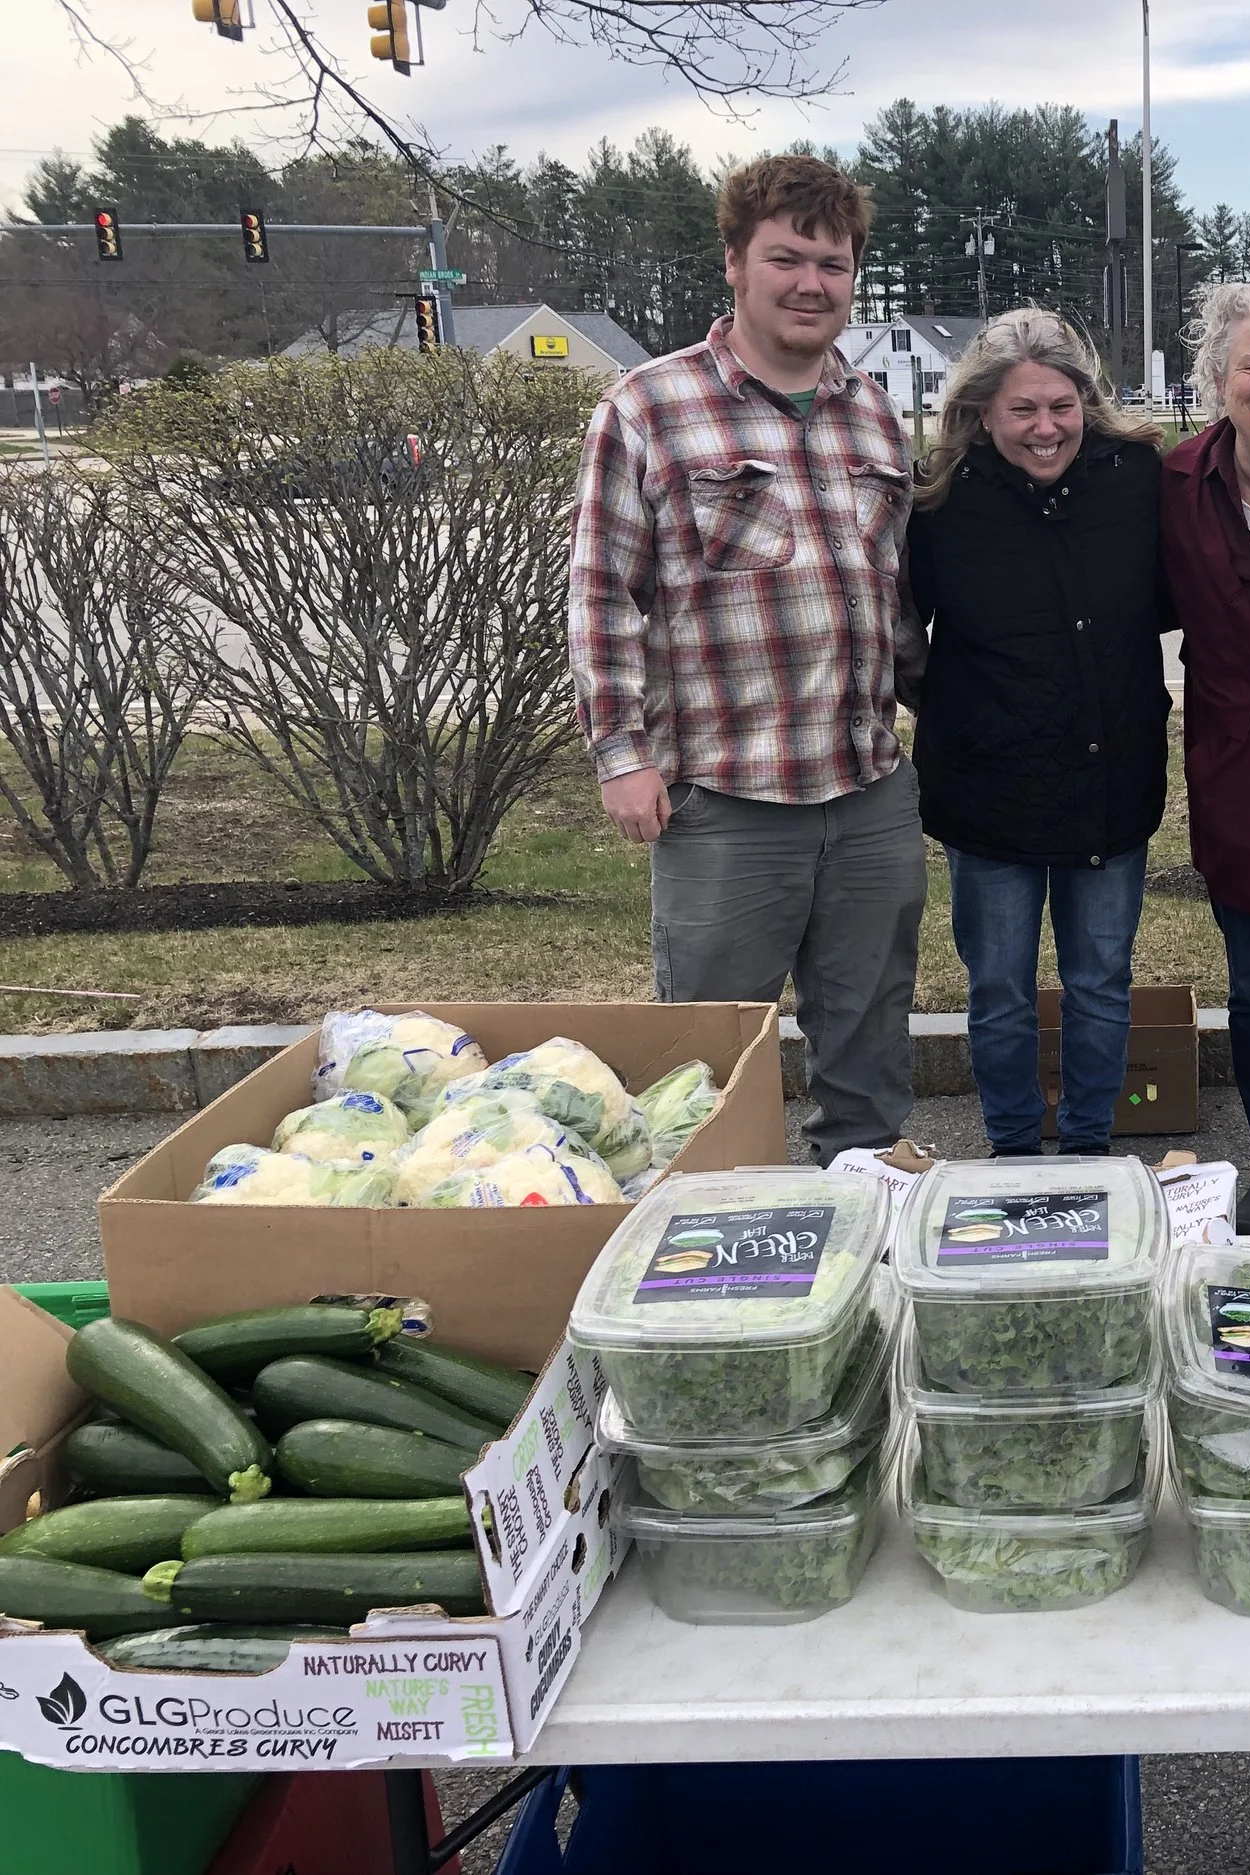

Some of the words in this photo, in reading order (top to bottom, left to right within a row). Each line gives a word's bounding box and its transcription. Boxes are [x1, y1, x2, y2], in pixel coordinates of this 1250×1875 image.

[1166, 1178, 1220, 1196] TURALLY
[1003, 1209, 1101, 1238] GREEN
[1024, 1206, 1048, 1217] LEAF
[740, 1225, 767, 1240] LEAF
[711, 1230, 819, 1269] GREEN
[780, 1251, 815, 1263] BETTER
[672, 1277, 707, 1285] CUT
[716, 1275, 781, 1283] SINGLE
[497, 1489, 516, 1548] SMART
[506, 1485, 528, 1555] CHOICE
[510, 1549, 523, 1587] THE
[538, 1616, 561, 1675] CURVY
[303, 1653, 418, 1676] NATURALLY
[423, 1651, 487, 1673] CURVY
[530, 1627, 572, 1720] CUCUMBERS
[366, 1678, 449, 1698] NATURE'S
[99, 1694, 357, 1728] GLGProduce
[389, 1697, 431, 1717] WAY
[459, 1684, 498, 1755] FRESH
[318, 1728, 359, 1736] Company
[377, 1721, 444, 1741] MISFIT
[66, 1735, 248, 1759] CONCOMBRES
[256, 1738, 338, 1760] CURVY
